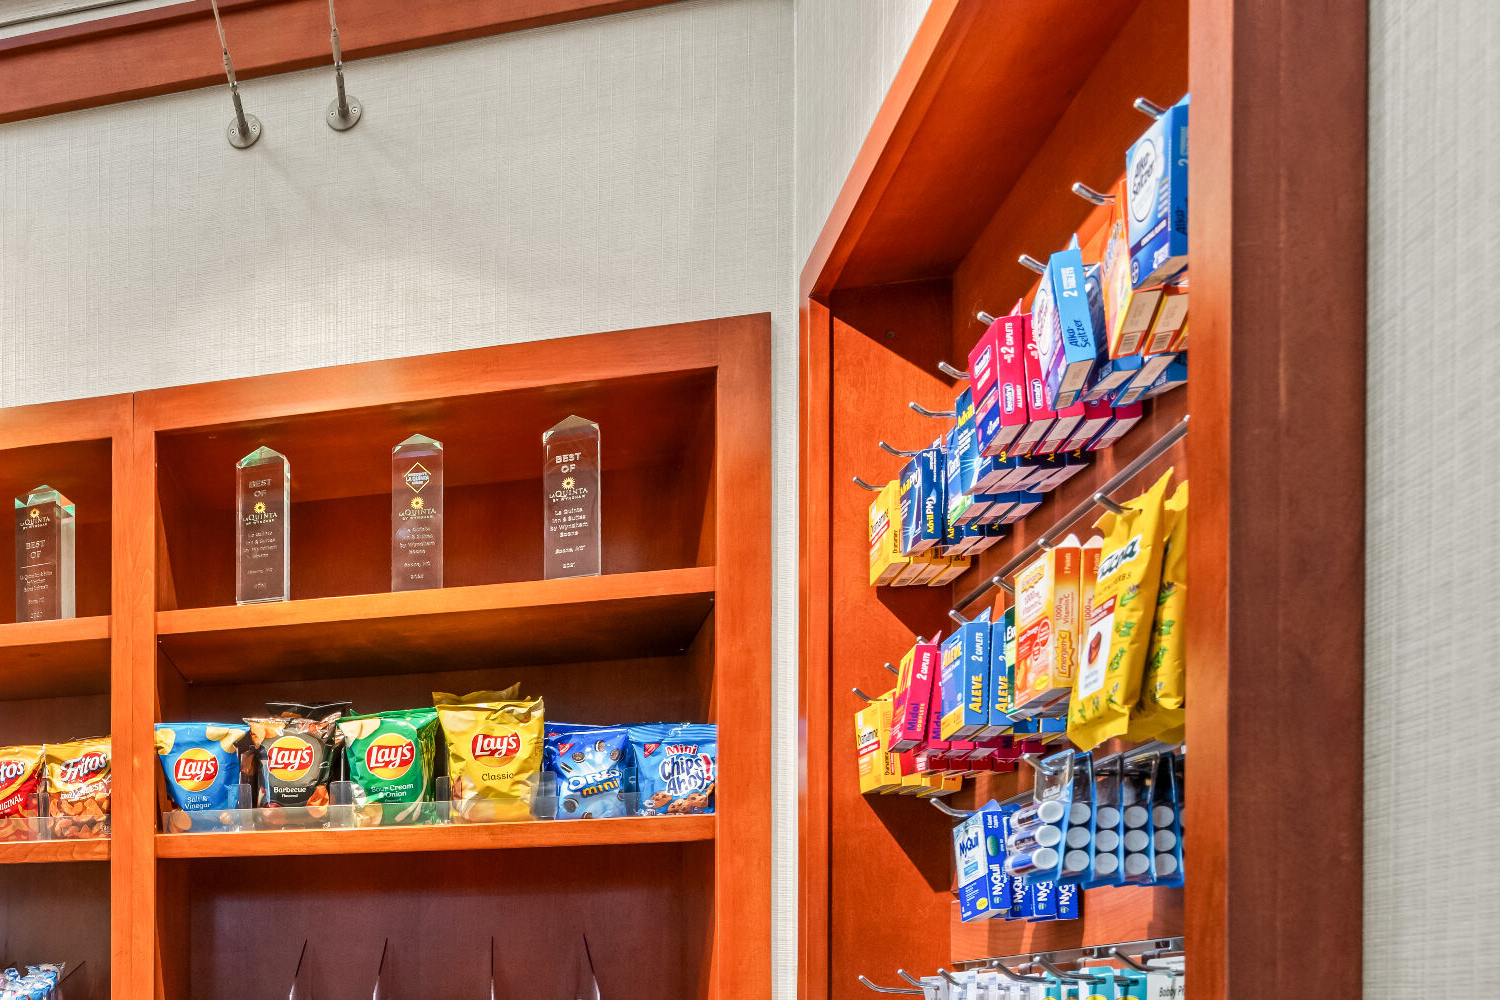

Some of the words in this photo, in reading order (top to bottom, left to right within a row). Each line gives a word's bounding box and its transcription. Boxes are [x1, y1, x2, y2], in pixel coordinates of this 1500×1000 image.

[1080, 320, 1090, 347] Seltzer
[555, 452, 581, 464] BEST
[561, 464, 576, 473] OF
[249, 478, 272, 488] BEST
[555, 488, 588, 498] QUINTA
[248, 512, 278, 522] QUINTA
[405, 509, 436, 518] QUINTA
[24, 517, 50, 526] QUINTA
[26, 540, 45, 549] BEST
[969, 675, 982, 713] ALEVE
[995, 676, 1008, 713] ALEVE
[907, 704, 919, 730] Midol
[474, 732, 518, 756] Lay's
[666, 744, 698, 756] Mini
[269, 746, 311, 771] Lay's
[369, 744, 412, 770] Lay's
[59, 752, 108, 782] Fritos
[177, 759, 216, 782] Lay's
[660, 756, 704, 782] Chips
[481, 772, 514, 782] Classic
[568, 769, 622, 790] OREO
[385, 790, 407, 798] Onion
[389, 783, 414, 791] Cream
[582, 778, 619, 797] mini
[184, 802, 211, 810] Vinegar
[990, 864, 1002, 895] NyQuil
